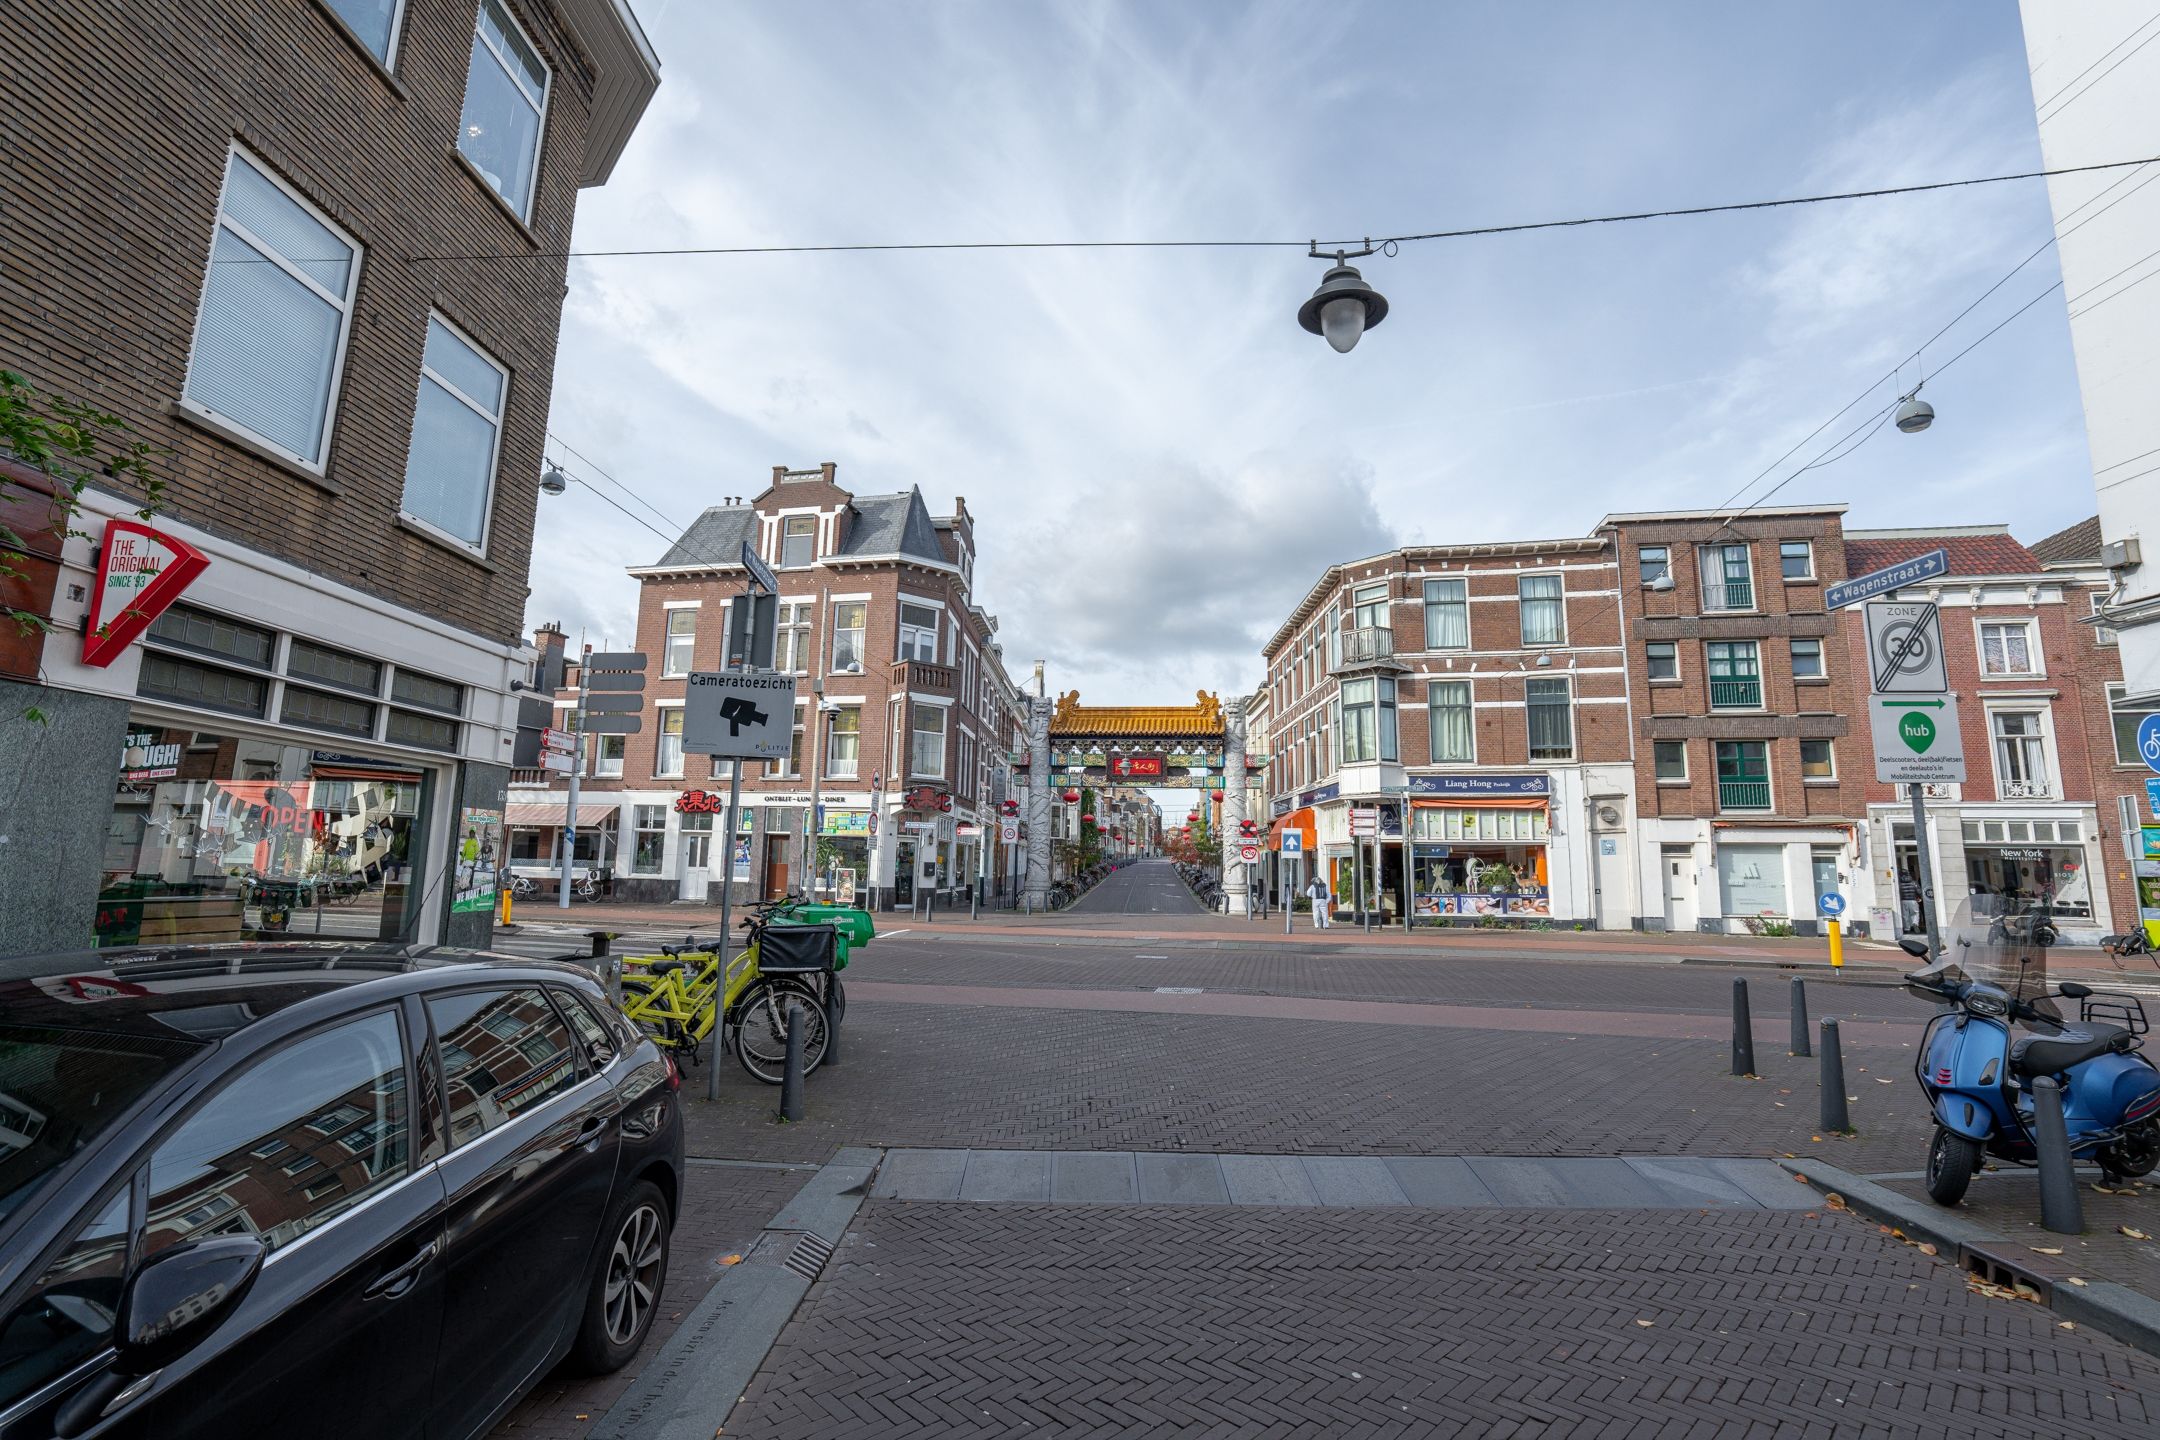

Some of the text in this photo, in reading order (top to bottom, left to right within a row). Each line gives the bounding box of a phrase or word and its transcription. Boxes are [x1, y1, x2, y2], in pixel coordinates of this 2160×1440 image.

[114, 539, 135, 556] THE
[108, 575, 132, 587] SINCE
[1842, 563, 1921, 599] Wagenstraat
[1887, 607, 1918, 616] ZONE
[1890, 636, 1925, 658] 30
[690, 673, 793, 691] Cameratoezicht
[1905, 724, 1930, 737] hub
[136, 733, 153, 746] THE
[1445, 779, 1468, 789] Liang
[1469, 779, 1492, 789] Hong
[261, 805, 325, 832] OPEN
[2000, 849, 2044, 857] New York
[717, 1299, 734, 1311] As
[697, 1312, 721, 1333] men
[680, 1334, 704, 1355] sizt
[654, 1370, 678, 1391] der
